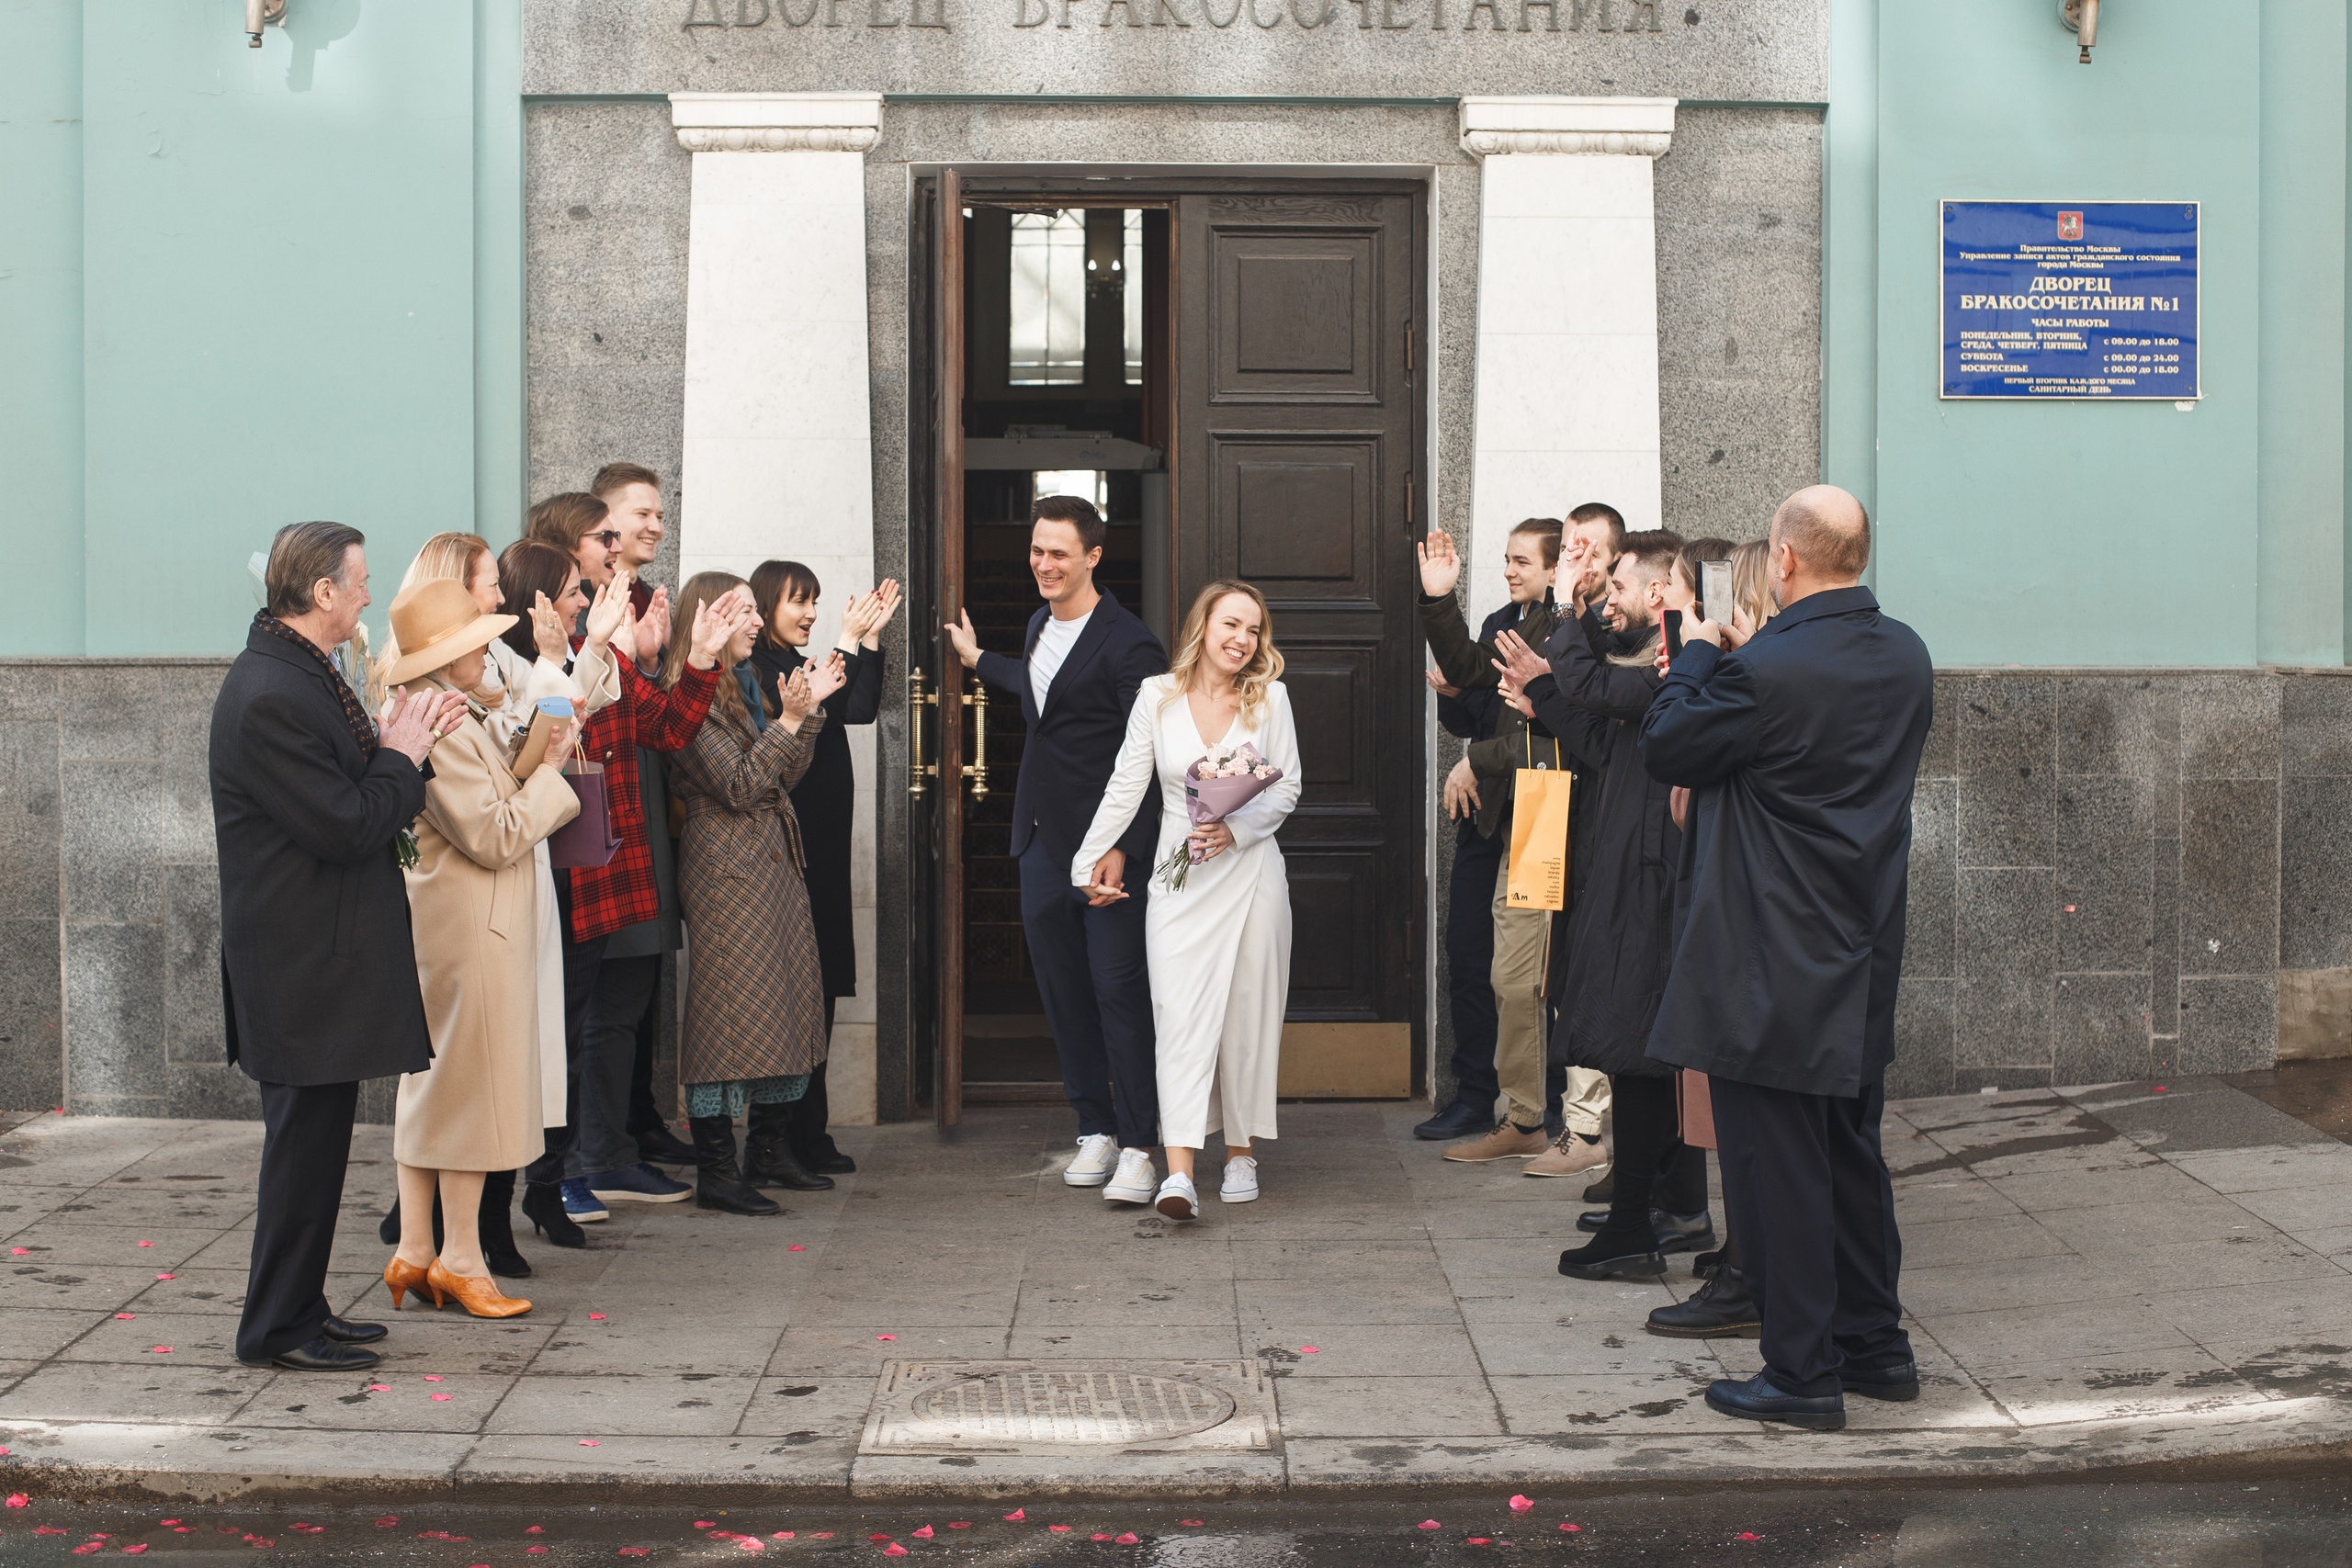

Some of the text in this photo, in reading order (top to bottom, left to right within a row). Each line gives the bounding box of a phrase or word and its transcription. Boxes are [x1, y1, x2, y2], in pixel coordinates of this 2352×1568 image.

[2020, 244, 2085, 254] Правительство
[1960, 252, 2011, 261] Управление
[2030, 276, 2111, 295] ДВОРЕЦ
[1961, 295, 2144, 310] БРАКОСОЧЕТАНИЯ
[2031, 318, 2109, 327] ЧАСЫ РАБОТЫ
[1961, 332, 2083, 341] ПОНЕДЕЛЬНИК, ВТОРНИК,
[1961, 341, 2088, 351] СРЕДА, ЧЕТВЕРГ, ПЯТНИЦА
[2111, 337, 2138, 345] 09.00
[2139, 339, 2151, 347] до
[1961, 353, 2004, 361] СУББОТА
[2111, 354, 2138, 362] 09.00
[2154, 366, 2179, 374] 18.00
[2029, 385, 2112, 394] САНИТАРНЫЙ ДЕНЬ
